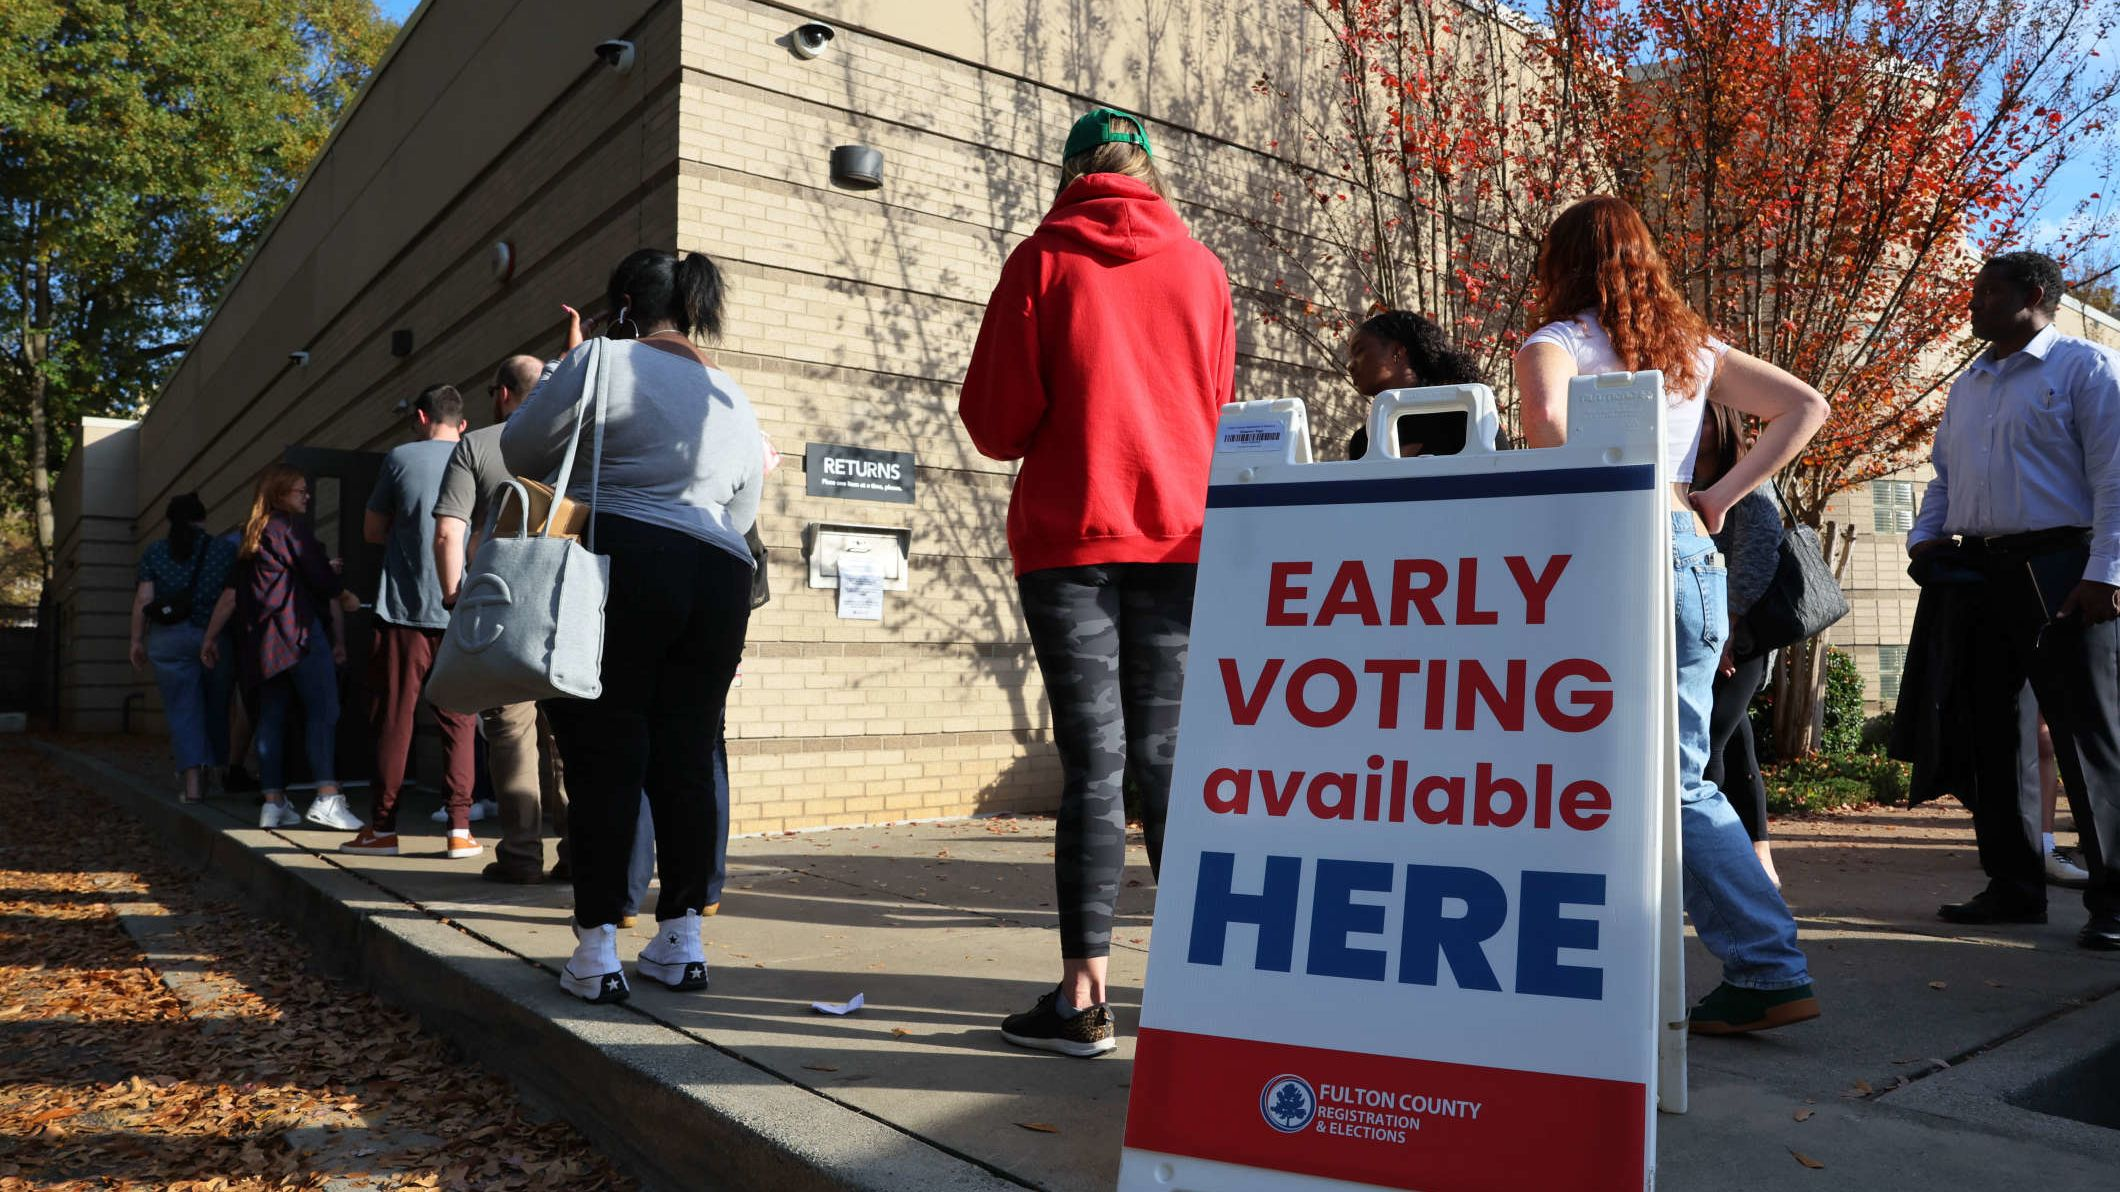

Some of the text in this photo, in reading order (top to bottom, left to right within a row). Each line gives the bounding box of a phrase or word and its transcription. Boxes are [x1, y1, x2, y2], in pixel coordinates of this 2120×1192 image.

[824, 457, 901, 480] RETURNS
[1266, 554, 1573, 626] EARLY
[1218, 658, 1613, 733] VOTING
[1203, 754, 1612, 831] available
[1187, 851, 1606, 1000] HERE
[1318, 1107, 1420, 1130] REGISTRATION
[1320, 1084, 1482, 1119] FULTON COUNTY
[1316, 1120, 1406, 1144] & ELECTIONS
